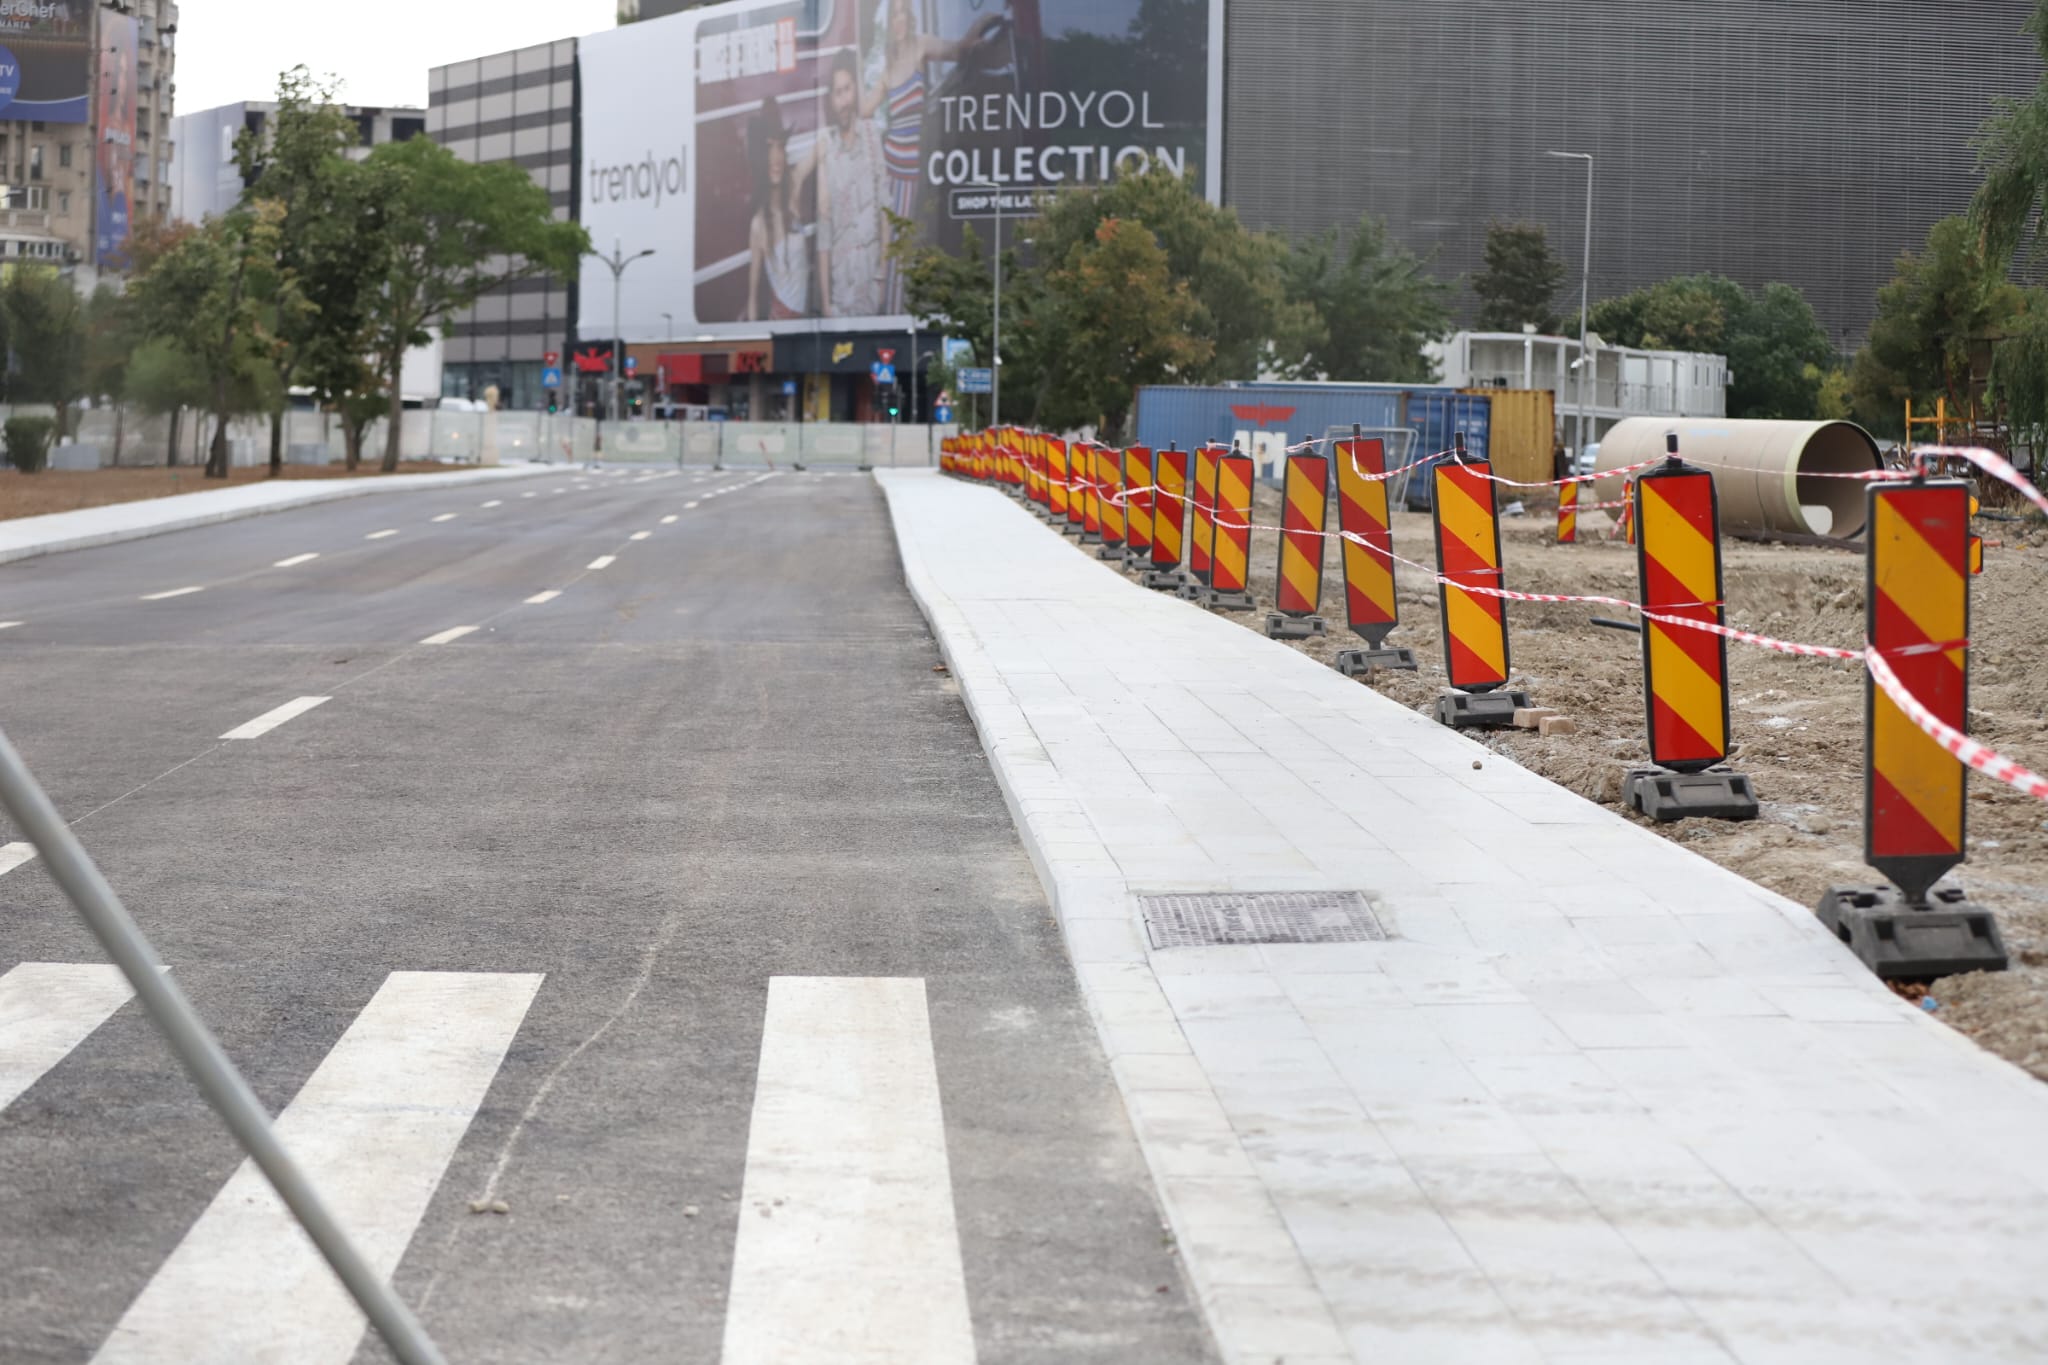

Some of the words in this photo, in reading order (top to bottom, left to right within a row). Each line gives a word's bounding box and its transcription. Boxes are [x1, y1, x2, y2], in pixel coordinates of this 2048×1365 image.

[940, 90, 1164, 133] TRENDYOL
[590, 144, 687, 209] trendyol
[927, 144, 1185, 186] COLLECTION
[957, 194, 988, 210] SHOP
[990, 194, 1014, 209] THE
